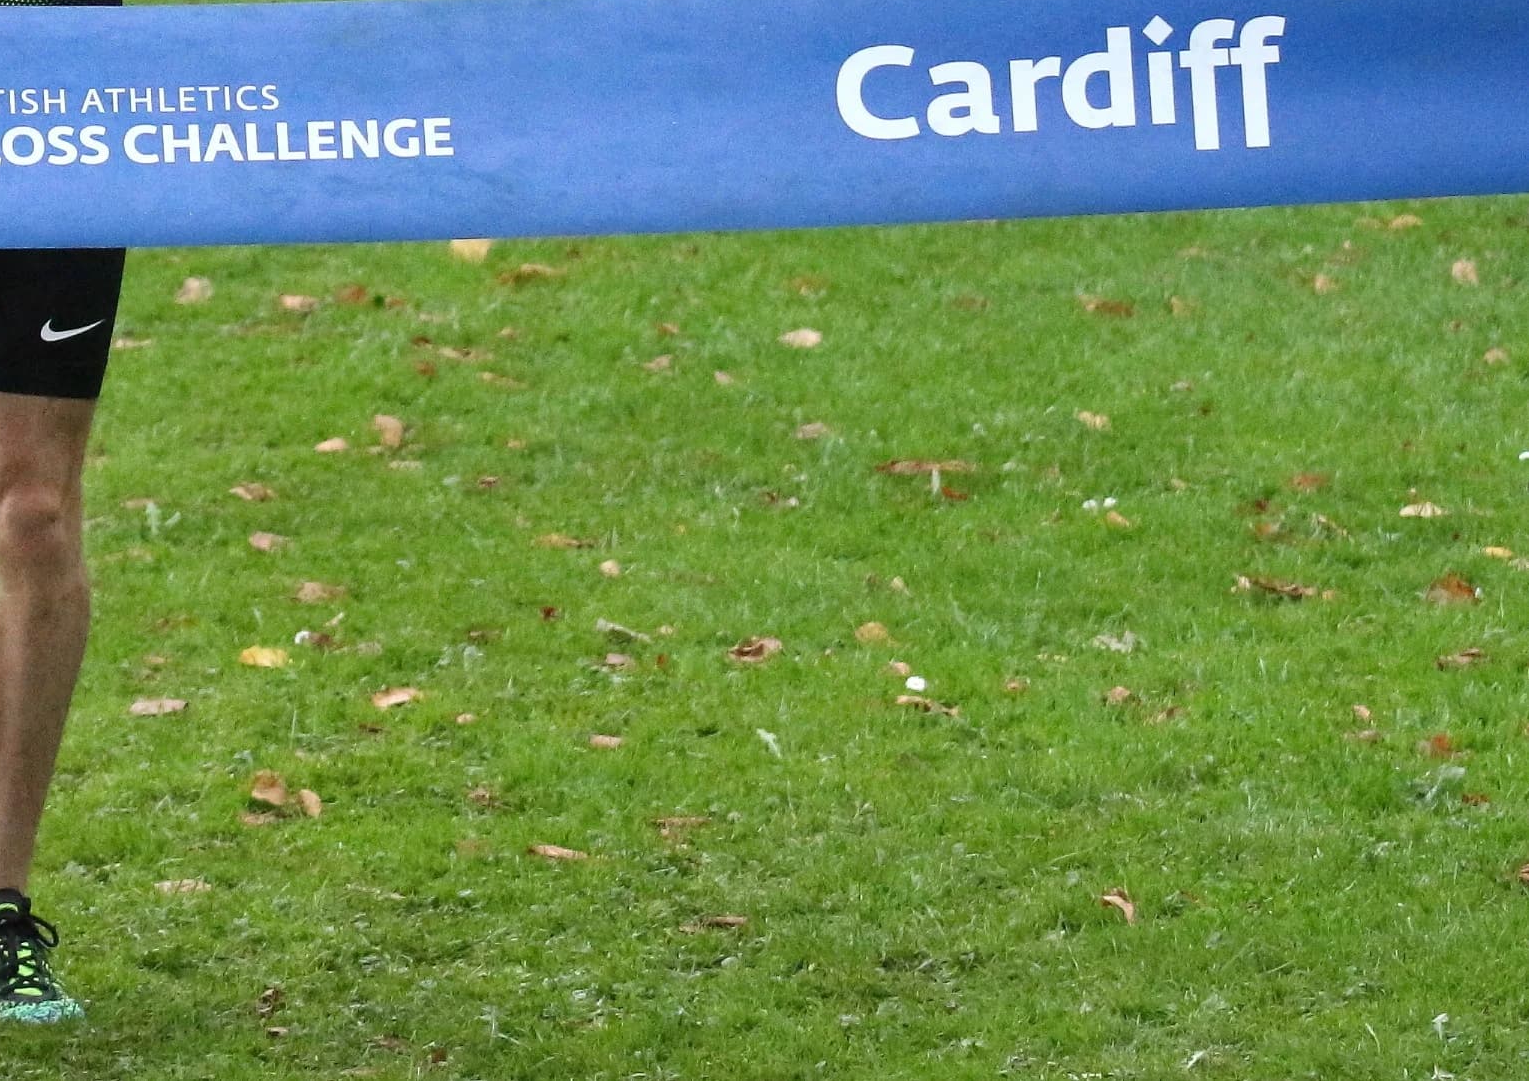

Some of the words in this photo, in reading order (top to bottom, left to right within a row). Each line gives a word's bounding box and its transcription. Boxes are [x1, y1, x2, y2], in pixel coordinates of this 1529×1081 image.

[81, 85, 280, 114] ATHLETICS
[836, 15, 1286, 151] Cardiff
[123, 118, 455, 164] CHALLENGE
